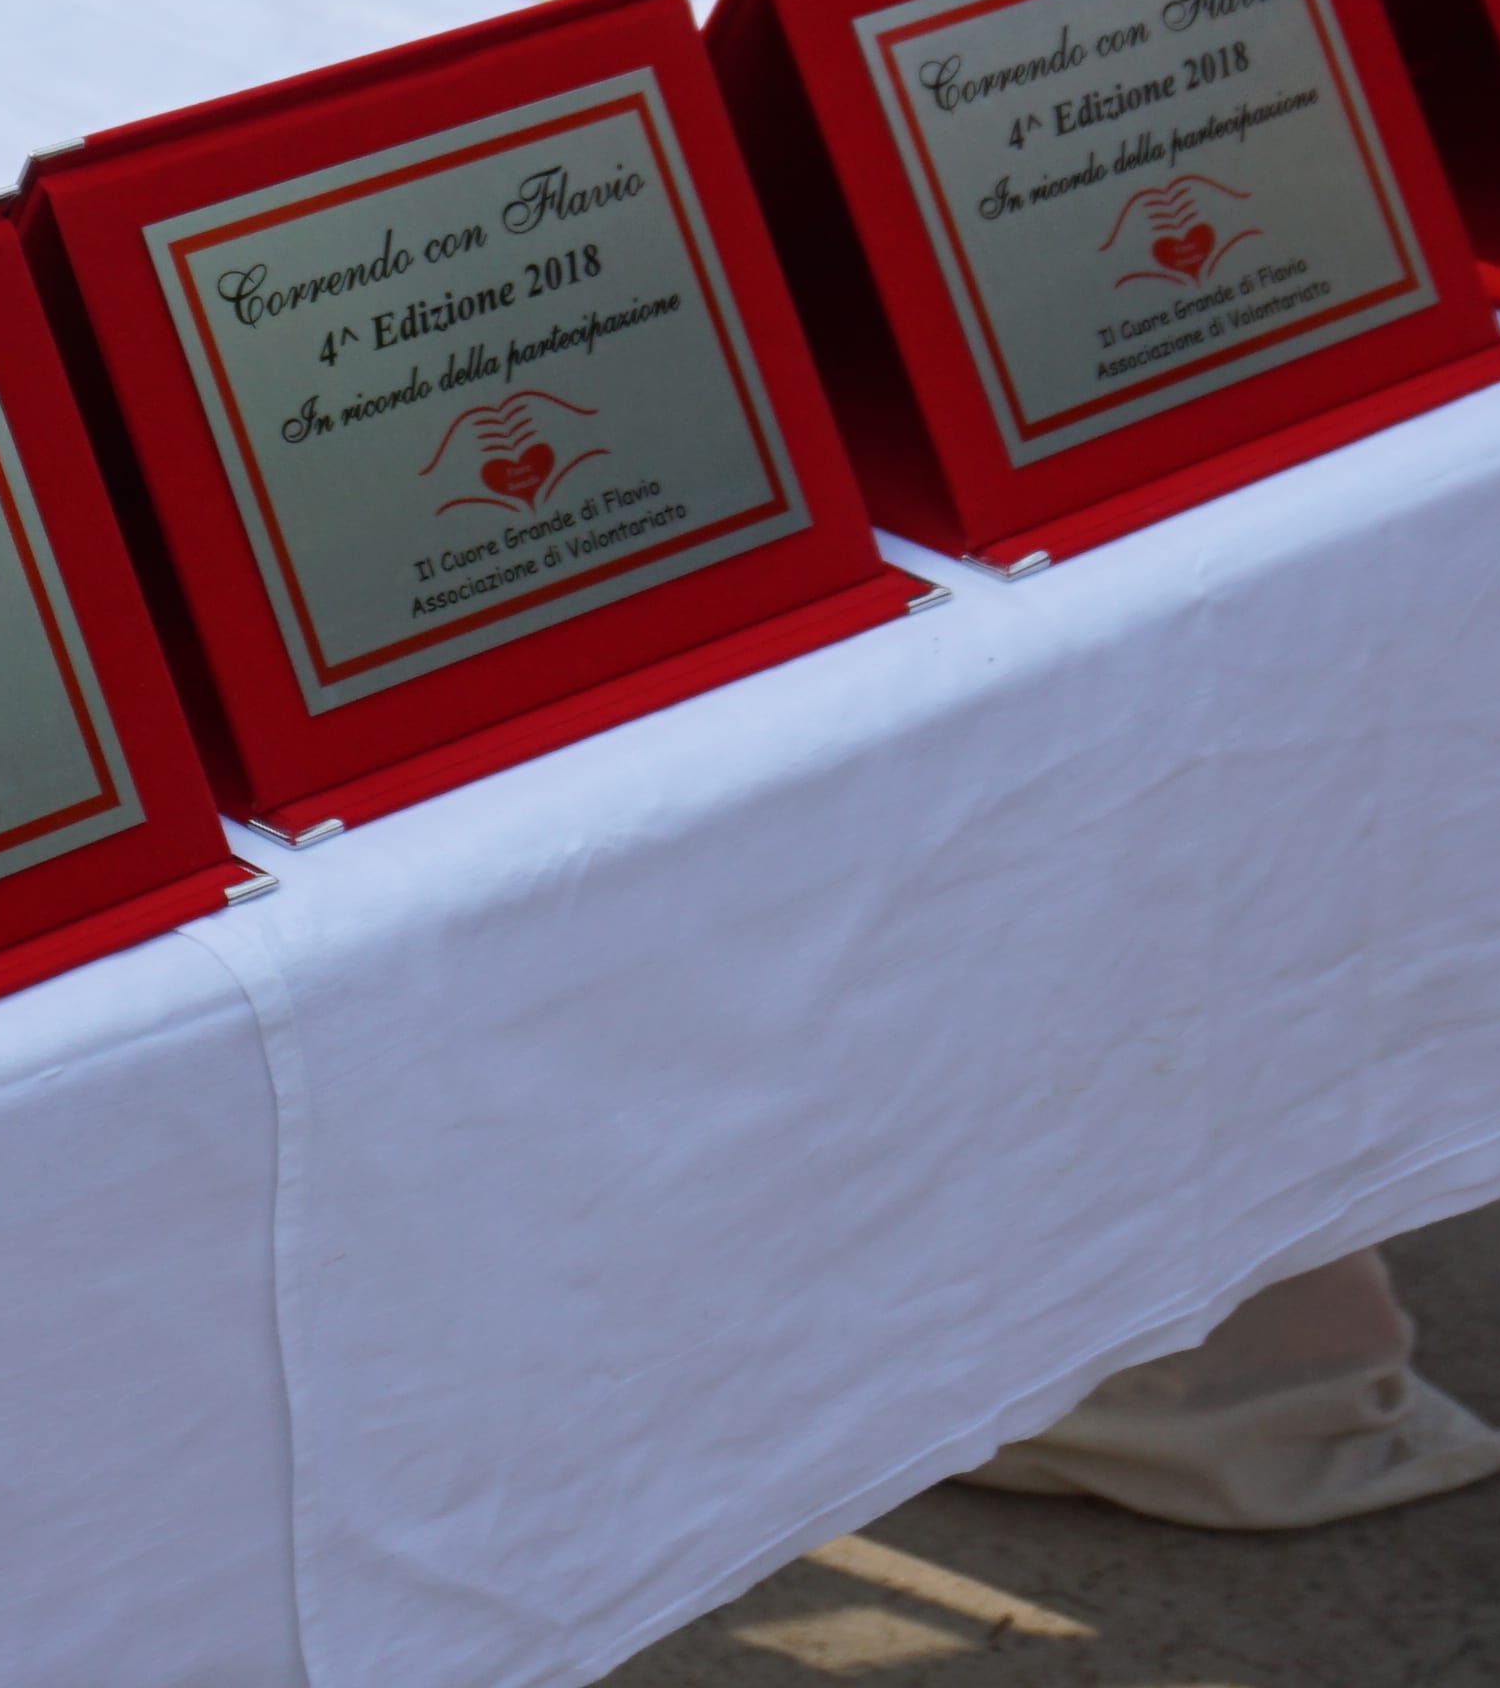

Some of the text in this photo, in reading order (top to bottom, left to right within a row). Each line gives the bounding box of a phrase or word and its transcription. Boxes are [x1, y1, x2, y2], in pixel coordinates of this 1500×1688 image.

[918, 23, 1088, 115] Correndo
[1095, 21, 1151, 57] con
[1008, 40, 1250, 151] 4^ Edizione 2018
[978, 86, 1320, 220] In ricordo della partecipazione
[216, 163, 646, 329] Correndo con Flavio
[1120, 310, 1171, 340] Cuore
[1173, 283, 1236, 320] Grande
[1238, 273, 1256, 294] di
[1256, 256, 1307, 288] Flavio
[319, 243, 602, 367] 4^ Edizione 2018
[1097, 280, 1331, 381] Associazione di Volontariato
[280, 292, 681, 444] In ricordo della partecipazione
[412, 502, 687, 618] Associazione di Volontariato
[414, 477, 660, 582] Il Cuore Grande di Flavio
